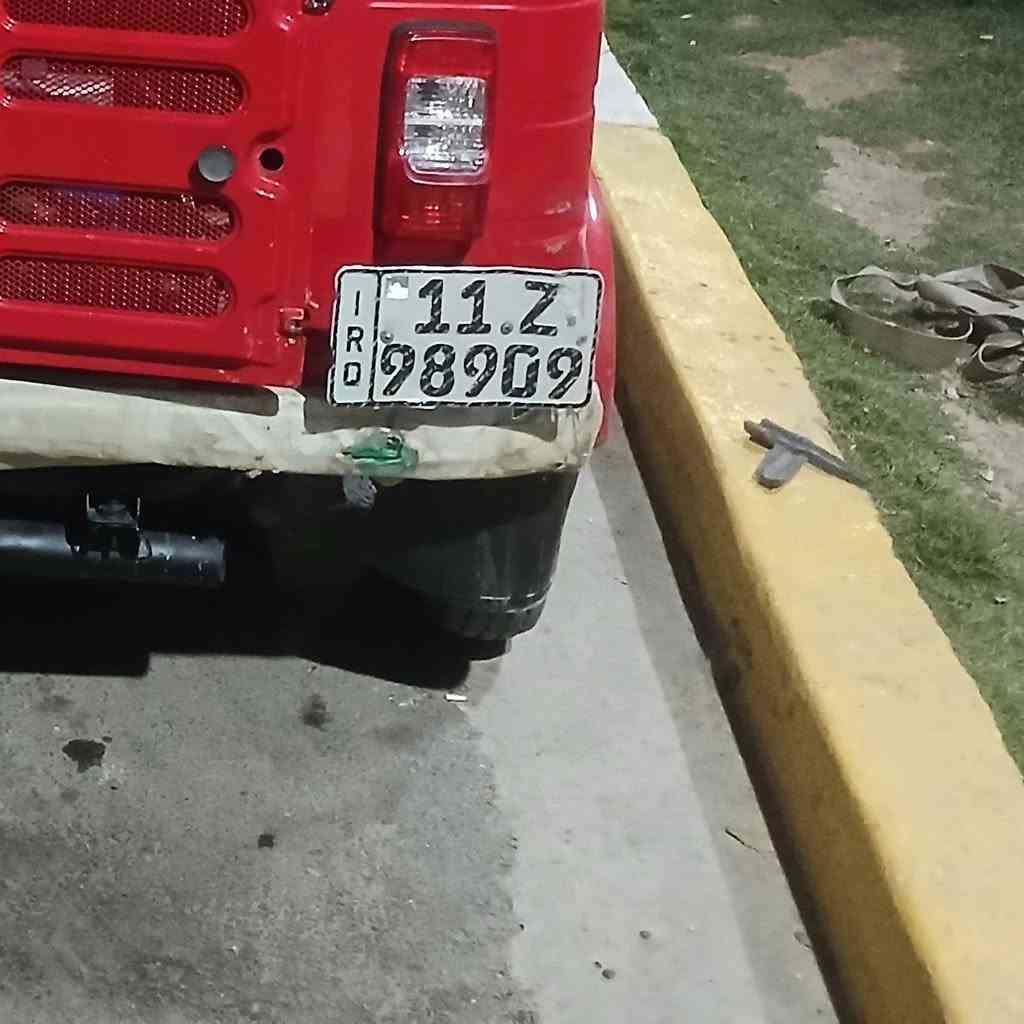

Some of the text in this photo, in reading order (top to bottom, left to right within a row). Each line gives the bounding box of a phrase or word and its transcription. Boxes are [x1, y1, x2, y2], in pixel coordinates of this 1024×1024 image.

[414, 278, 563, 337] 11 Z
[380, 343, 583, 400] 98909
